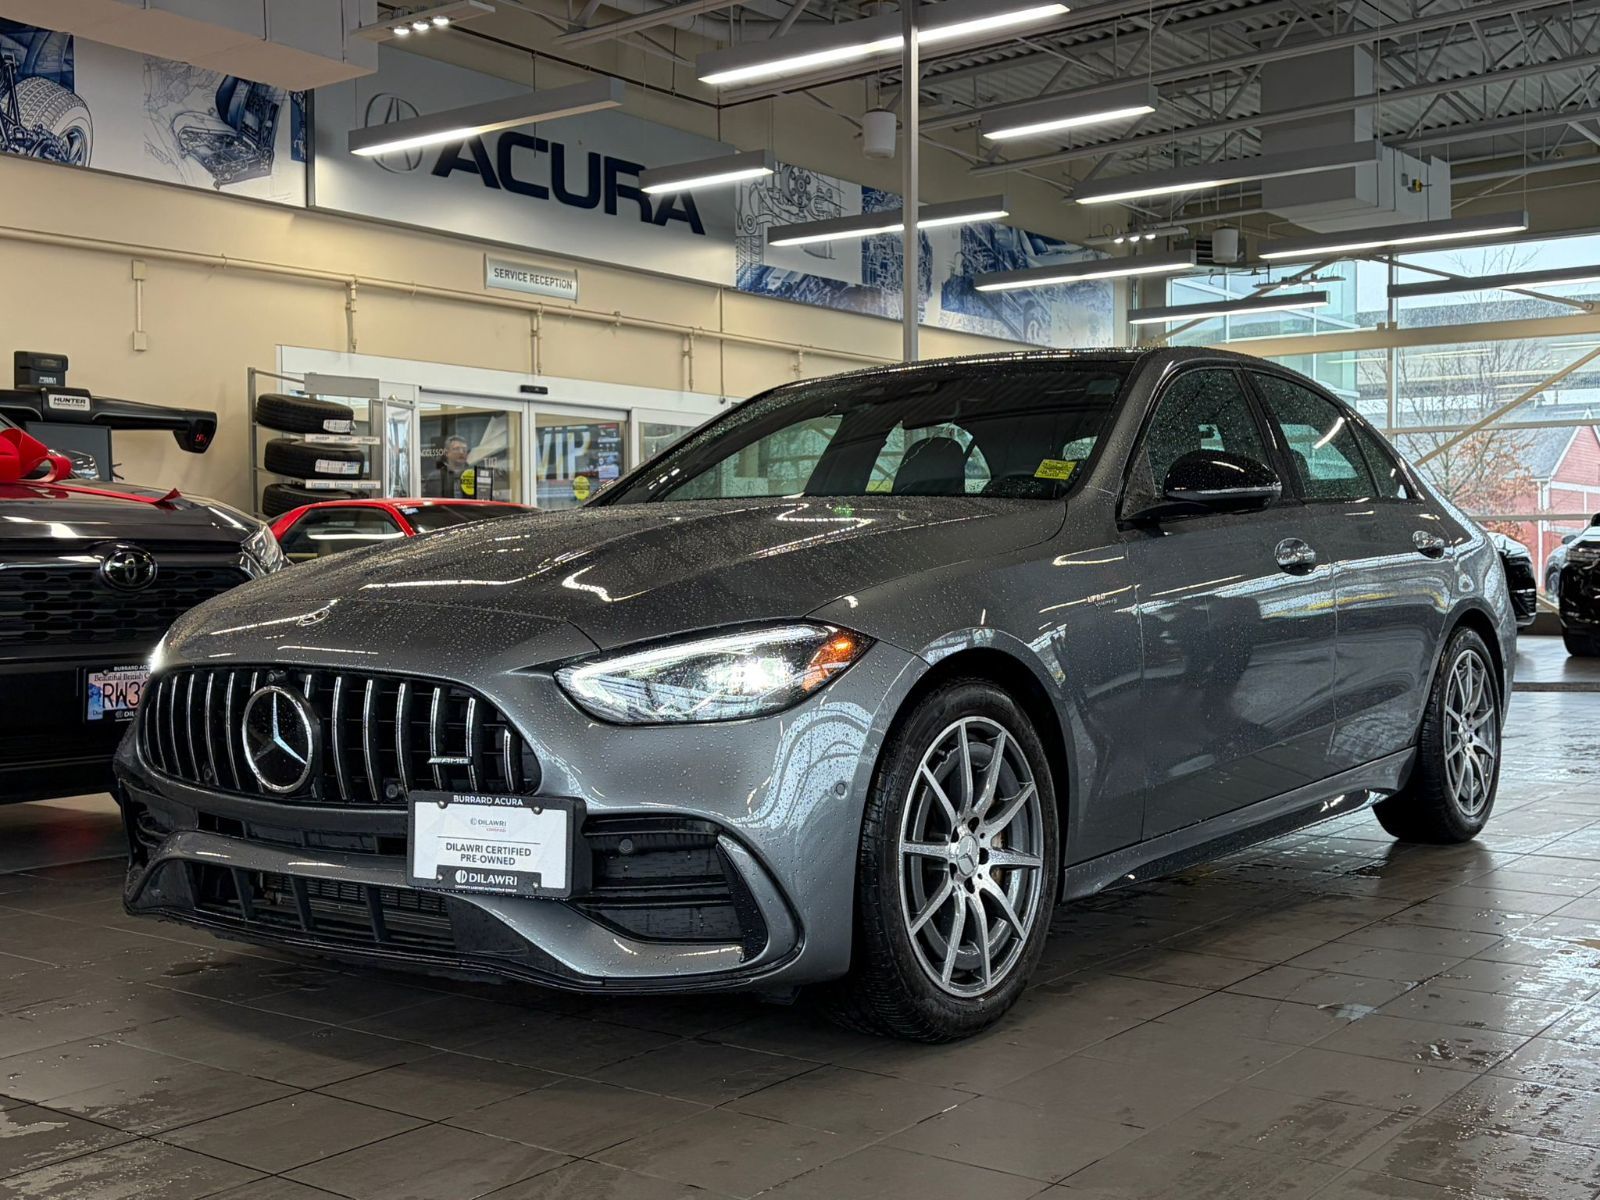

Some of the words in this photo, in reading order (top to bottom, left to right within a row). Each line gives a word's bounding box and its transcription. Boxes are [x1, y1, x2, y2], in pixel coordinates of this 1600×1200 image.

[431, 130, 706, 235] ACURA
[494, 267, 528, 282] SERVICE
[529, 274, 573, 290] RECEPTION
[453, 794, 493, 804] BURRARD
[495, 796, 524, 806] ACURA
[478, 819, 507, 827] DILAWRI
[446, 842, 483, 854] DILAWRI
[485, 845, 531, 857] CERTIFIED
[460, 854, 516, 866] PRE-OWNED
[468, 873, 518, 886] DILAWRI
